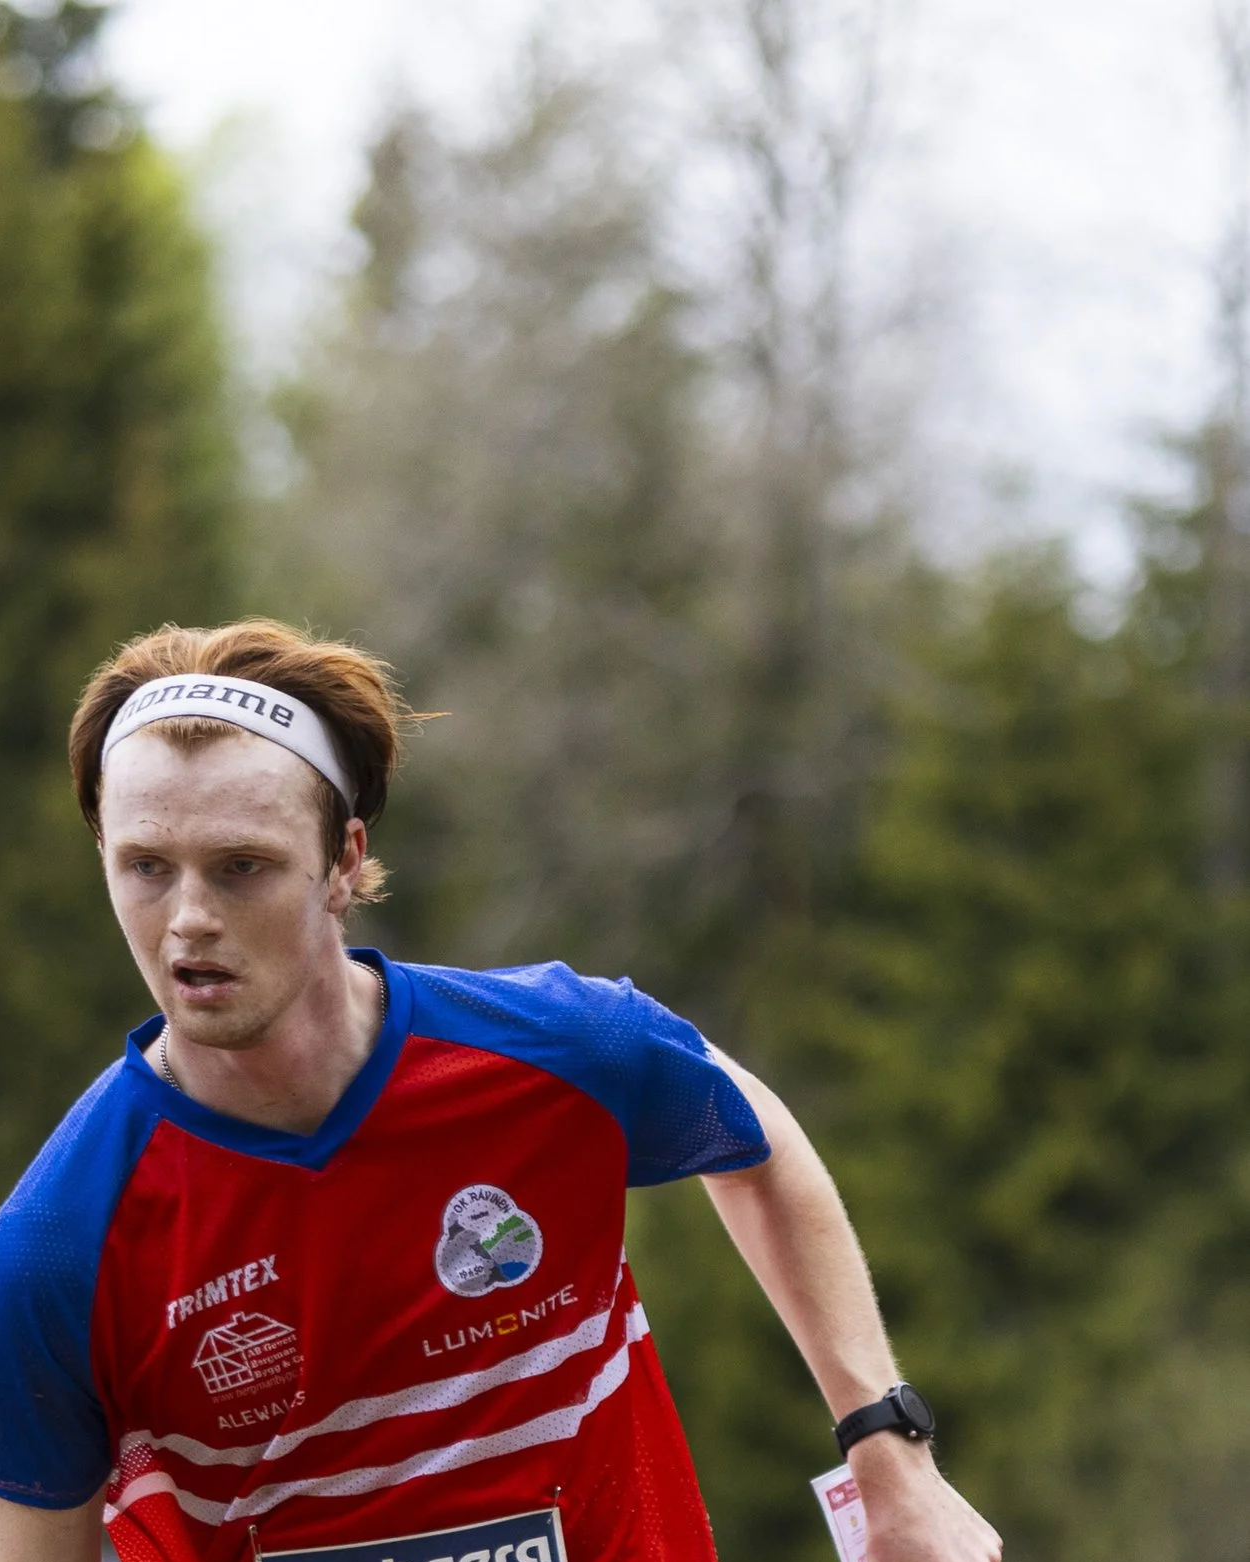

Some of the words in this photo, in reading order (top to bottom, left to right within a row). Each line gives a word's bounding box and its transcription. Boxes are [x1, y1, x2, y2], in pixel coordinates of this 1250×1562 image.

[453, 1198, 469, 1214] OK
[166, 1253, 280, 1330] TRIMTEX
[422, 1283, 579, 1358] LUMONITE
[253, 1363, 281, 1379] Bygg
